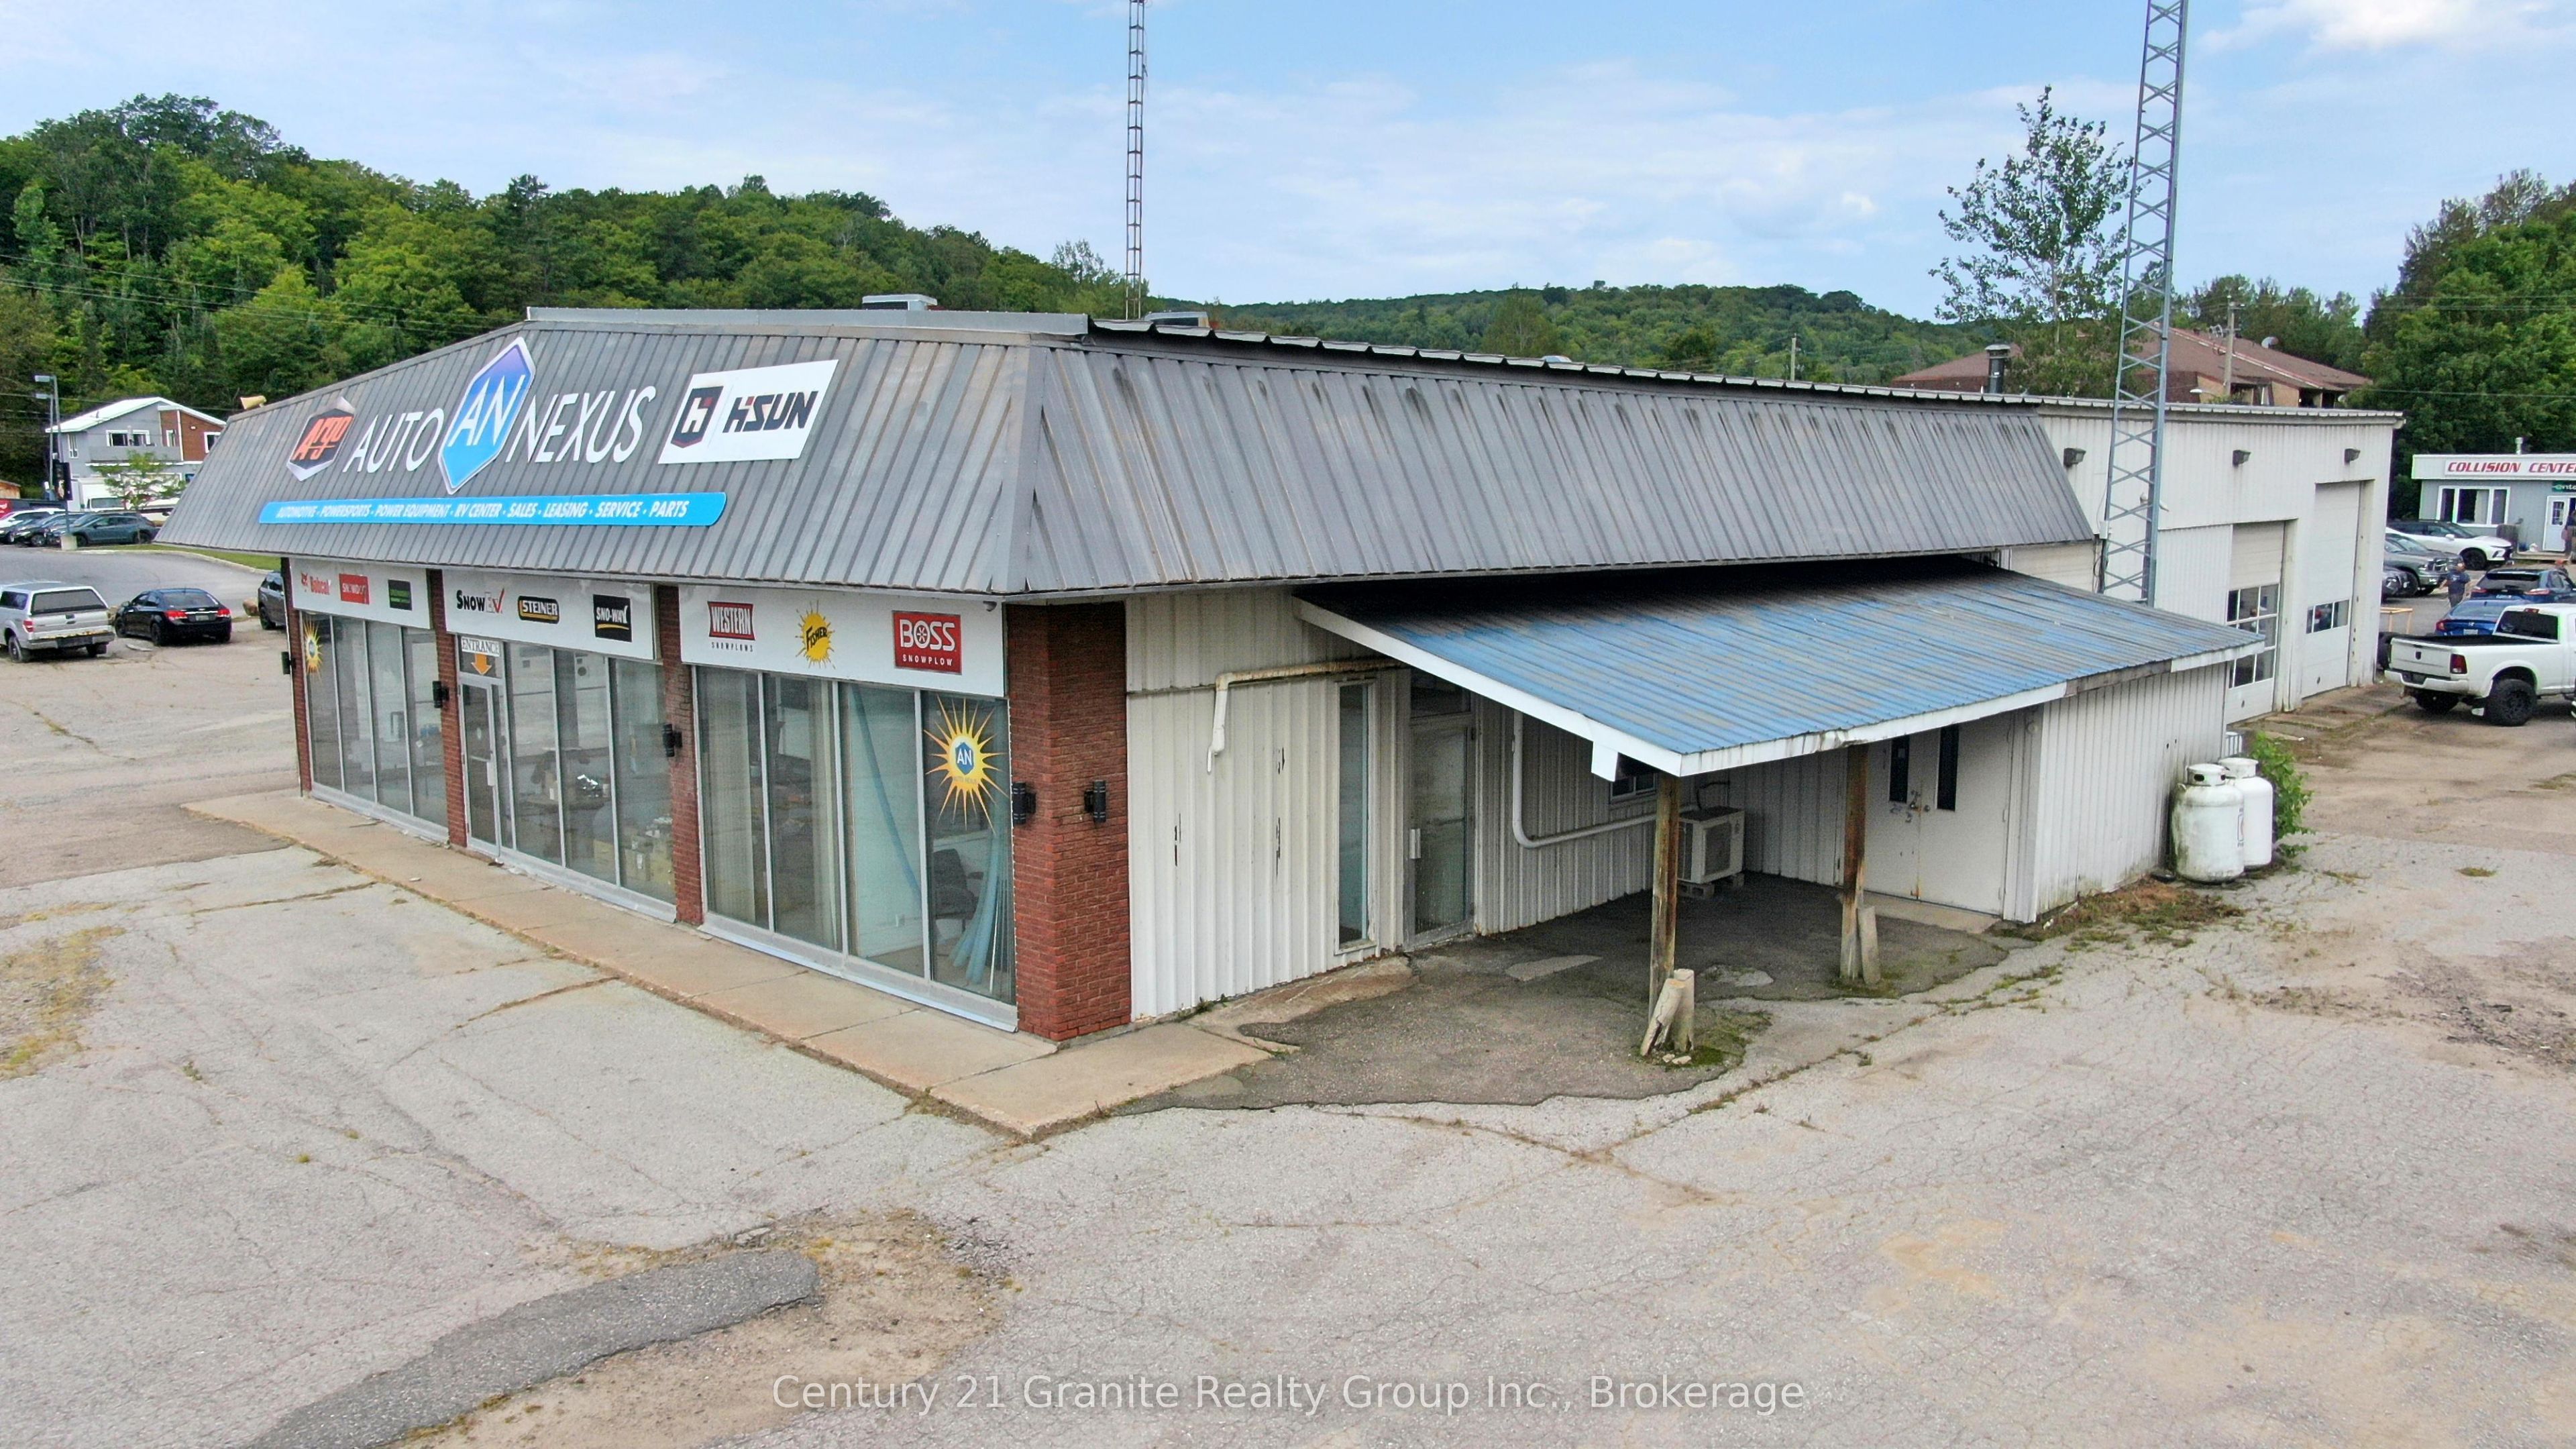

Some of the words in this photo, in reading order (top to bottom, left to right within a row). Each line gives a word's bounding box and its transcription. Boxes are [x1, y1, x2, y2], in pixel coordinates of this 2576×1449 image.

[342, 408, 444, 473] AUTO
[505, 386, 656, 463] NEXUS
[2448, 462, 2522, 473] COLLISION
[2528, 462, 2576, 473] CENTE
[276, 506, 318, 519] AUTOMOTIVE
[319, 504, 372, 517] POWERSPORTS
[374, 504, 405, 517] POWER
[402, 504, 452, 517] EQUIPMENT
[454, 504, 471, 517] RV
[468, 503, 502, 517] CENTER
[507, 502, 537, 518] SALES
[543, 502, 588, 518] LEASING
[594, 501, 643, 518] SERVICE
[649, 500, 690, 517] PARTS
[523, 600, 557, 615] STEINER
[596, 605, 628, 623] SNO-WAY
[711, 606, 751, 635] WESTERN
[900, 619, 955, 651] BOSS
[462, 638, 500, 655] ENTRANCE
[712, 642, 753, 652] SNOWPLOWS
[903, 654, 953, 666] SNOWPLOW
[957, 748, 972, 765] AN
